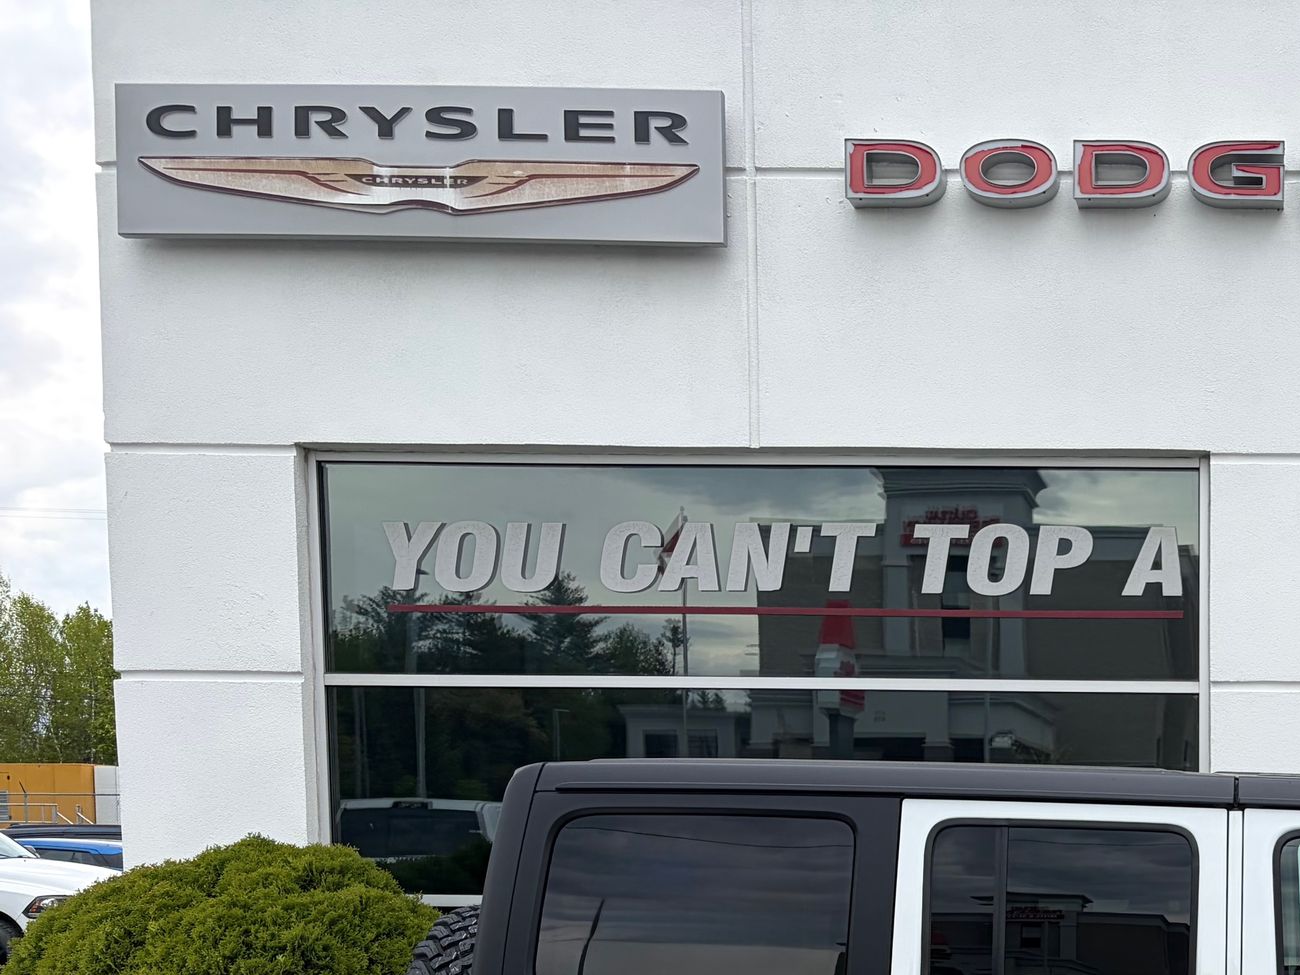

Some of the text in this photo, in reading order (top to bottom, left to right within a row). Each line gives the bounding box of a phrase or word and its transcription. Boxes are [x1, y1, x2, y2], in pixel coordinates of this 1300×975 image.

[145, 104, 689, 145] CHRYSLER
[361, 177, 468, 185] CHRYSLER
[382, 520, 1183, 597] YOU CAN'T TOP A
